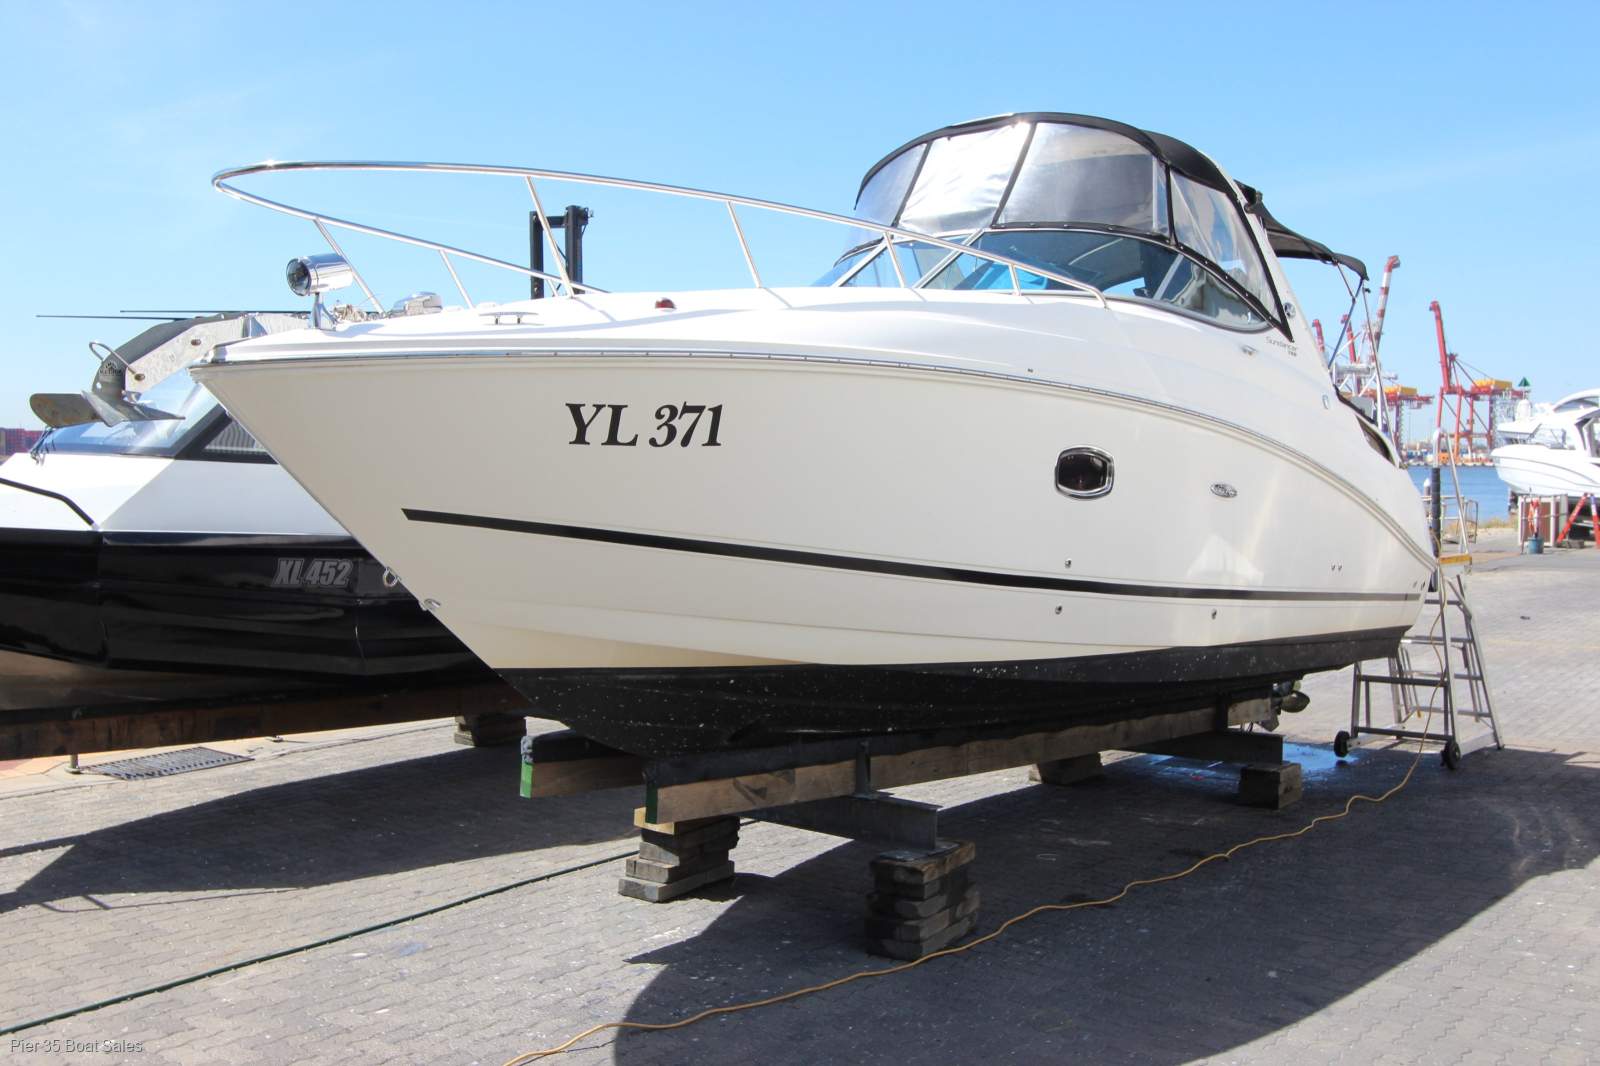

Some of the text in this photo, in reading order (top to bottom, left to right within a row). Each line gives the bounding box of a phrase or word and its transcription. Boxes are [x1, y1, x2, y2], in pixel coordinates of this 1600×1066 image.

[565, 401, 723, 448] YL 371
[272, 558, 353, 588] XL 452
